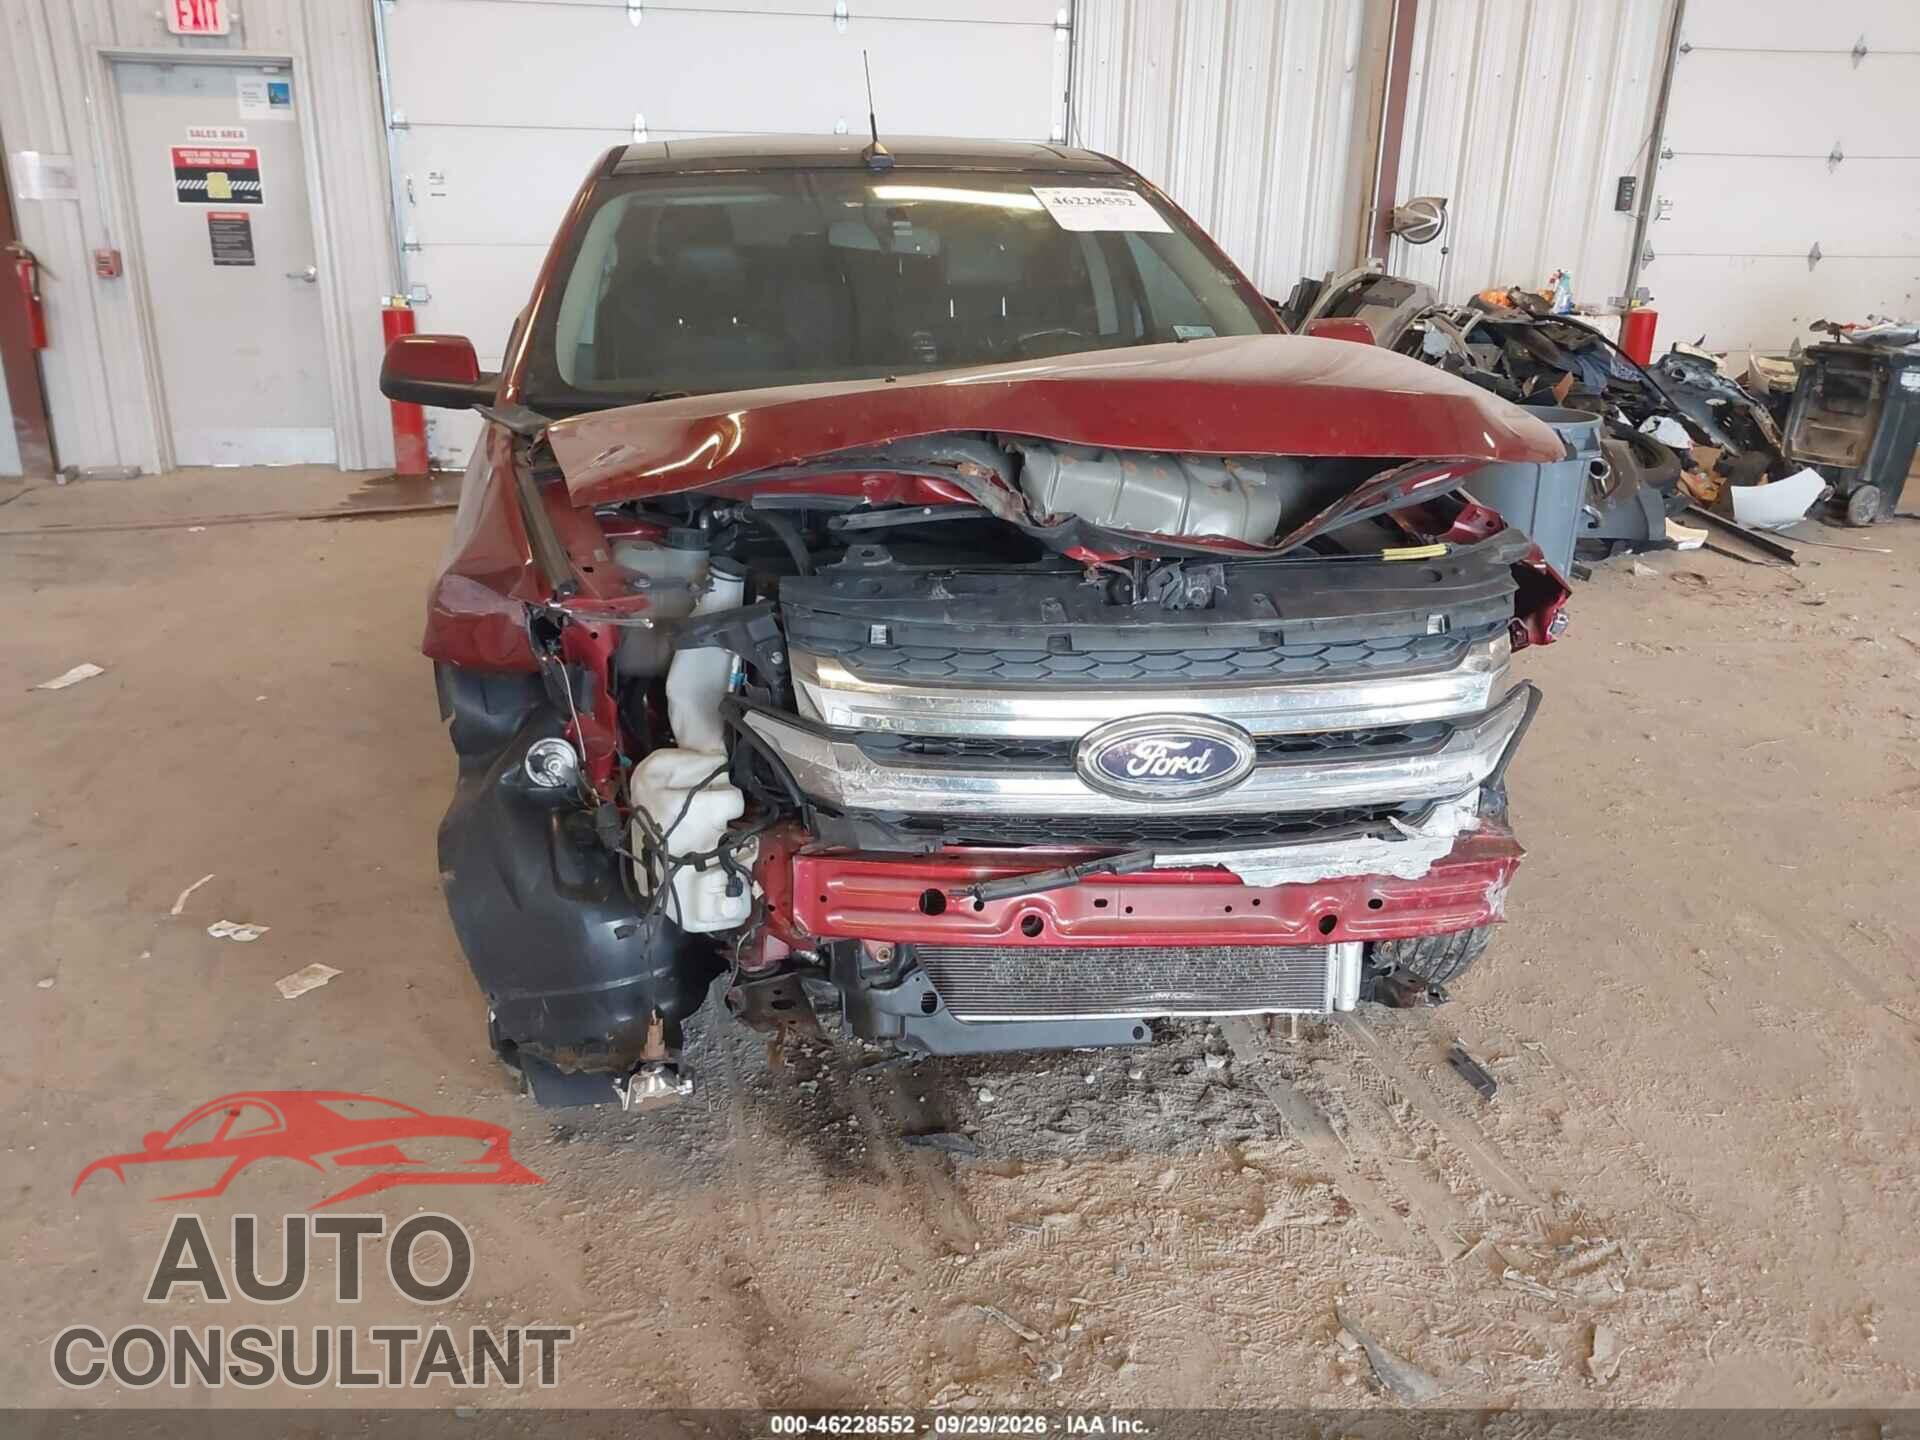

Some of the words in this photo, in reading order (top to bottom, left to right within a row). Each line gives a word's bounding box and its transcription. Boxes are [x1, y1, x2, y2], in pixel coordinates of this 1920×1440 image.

[175, 0, 218, 31] EXIT
[190, 129, 217, 138] SALES
[221, 130, 244, 138] AREA
[1053, 196, 1137, 206] 46228552
[1126, 739, 1213, 776] Ford
